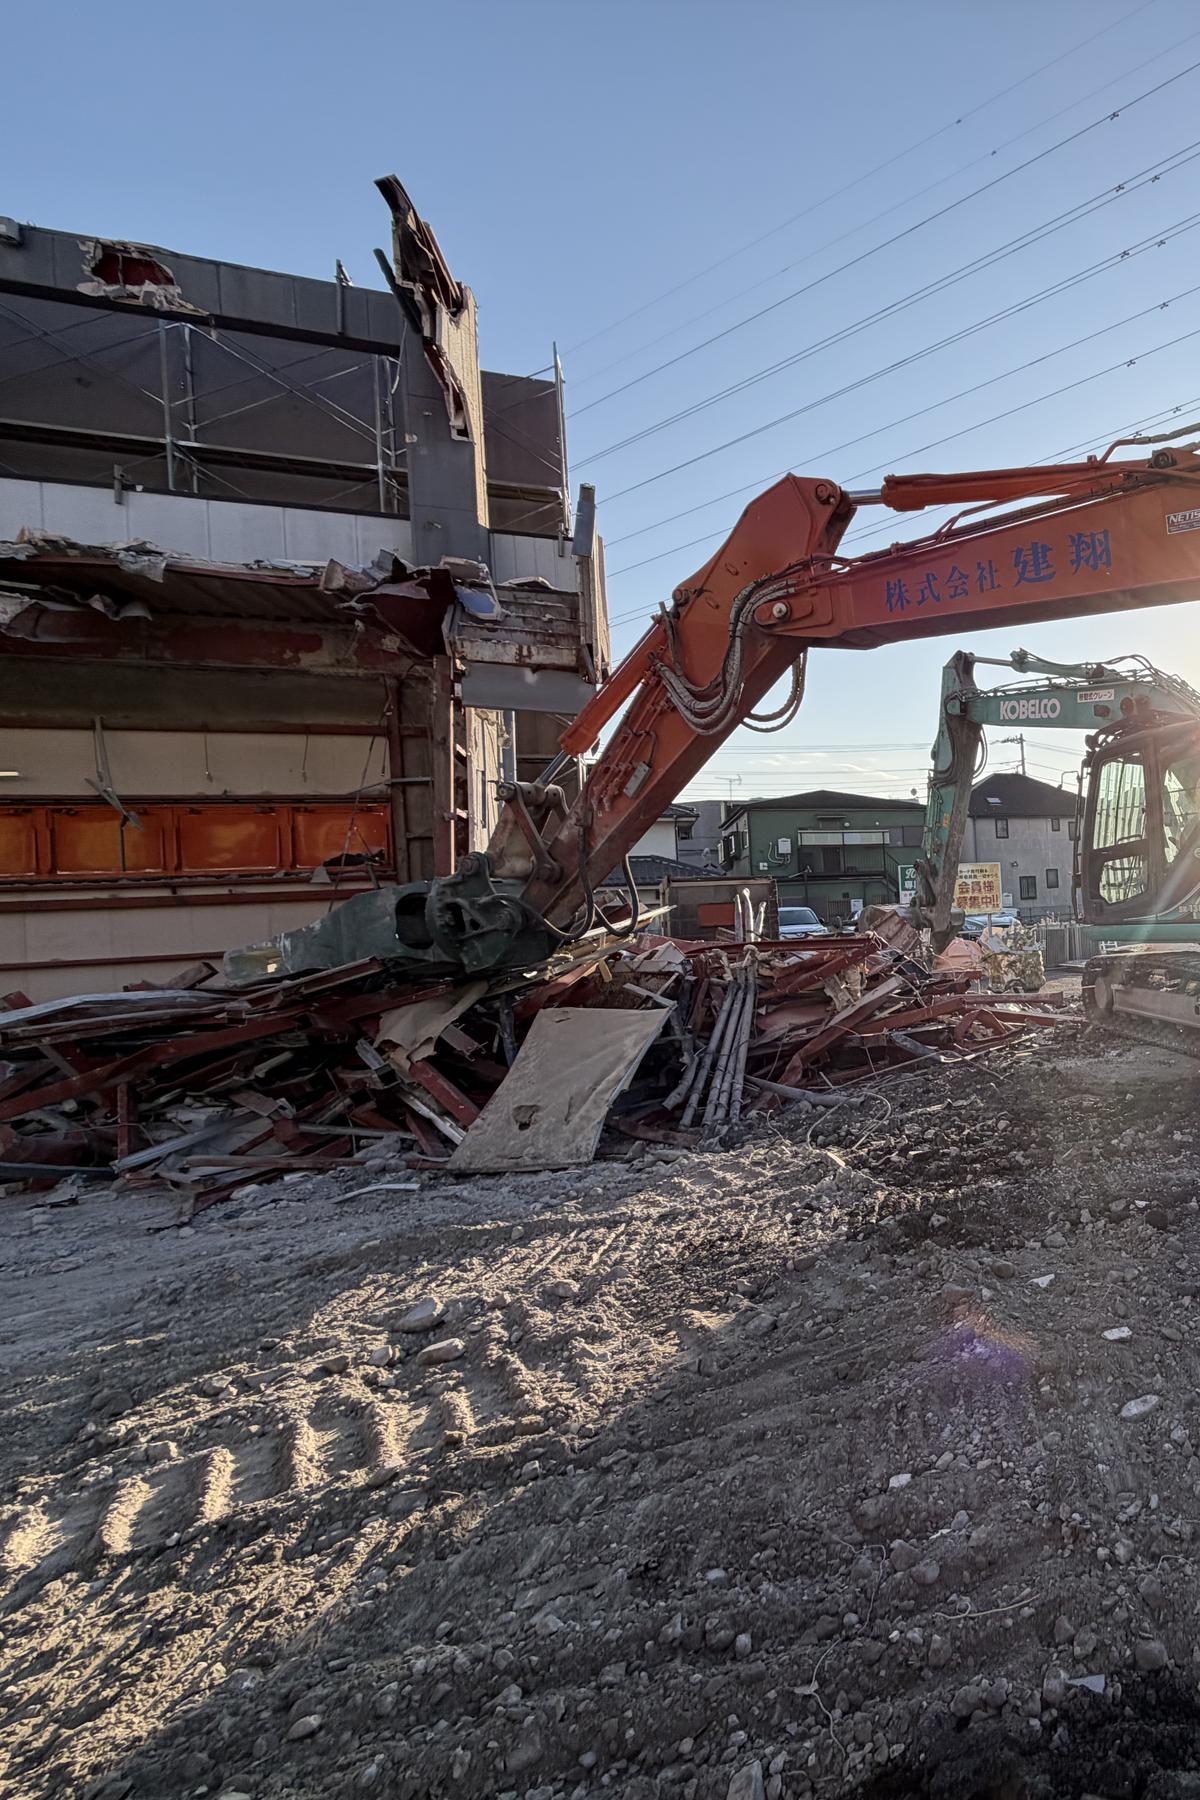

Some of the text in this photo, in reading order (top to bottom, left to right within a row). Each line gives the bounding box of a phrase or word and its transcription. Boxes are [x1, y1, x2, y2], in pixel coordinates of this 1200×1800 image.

[1000, 698, 1061, 720] KOBELCO
[958, 881, 994, 894] 会員様
